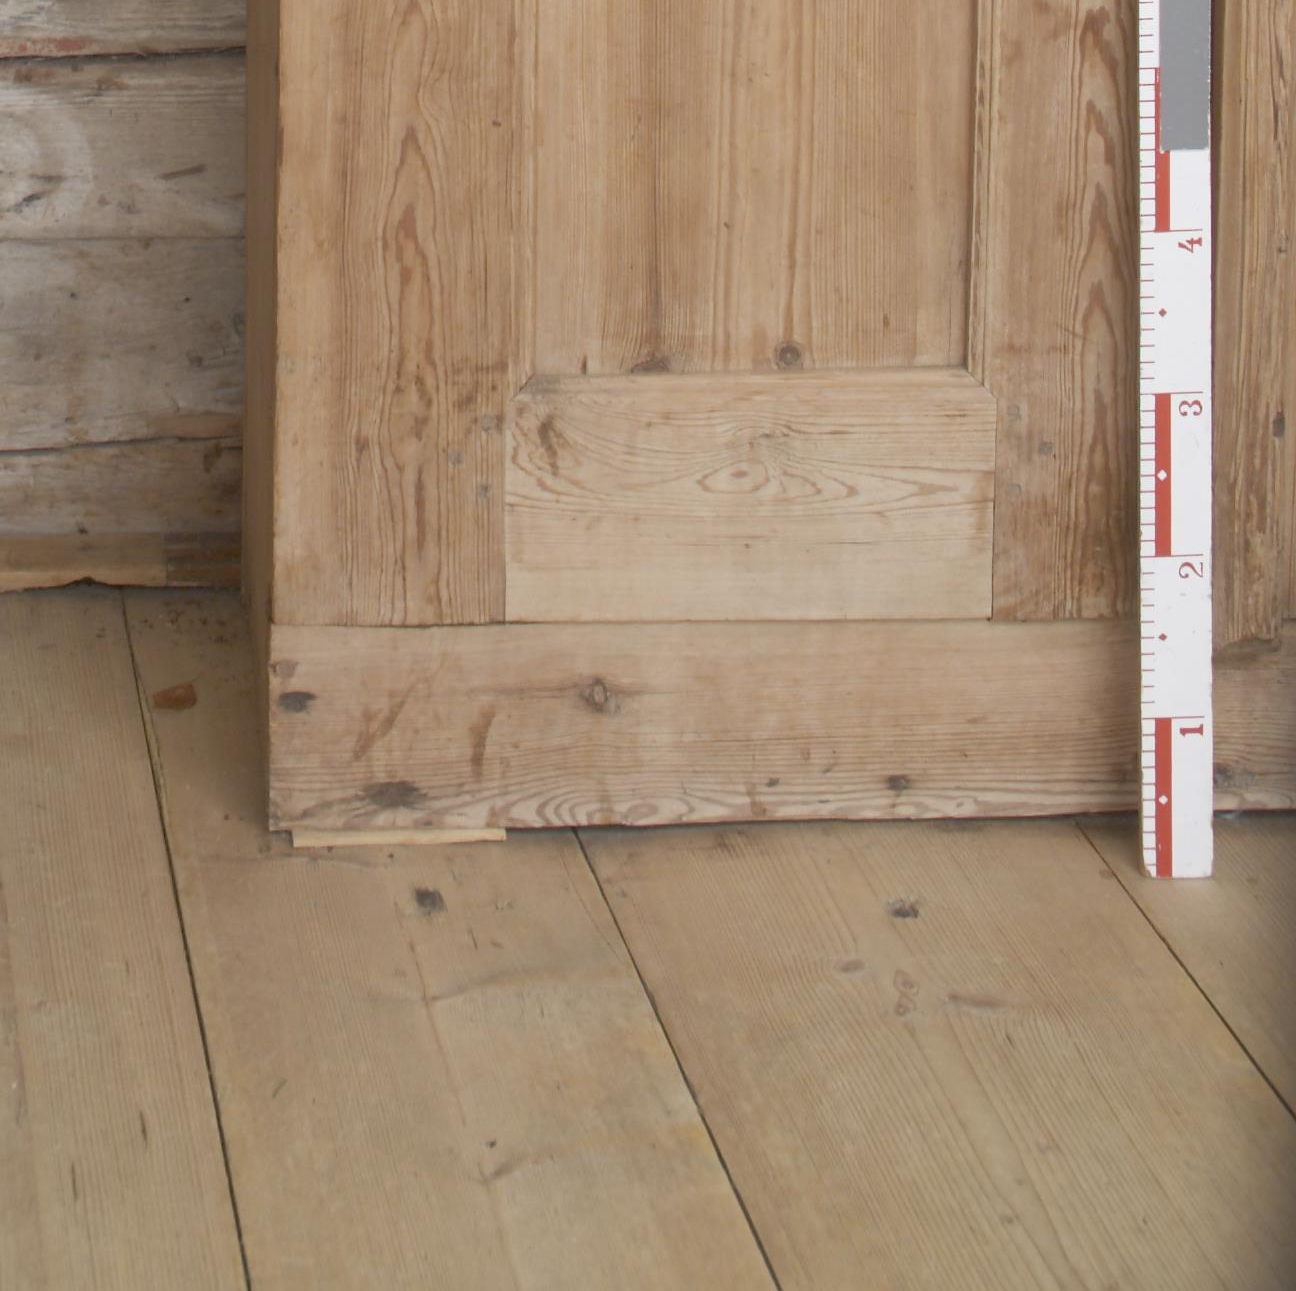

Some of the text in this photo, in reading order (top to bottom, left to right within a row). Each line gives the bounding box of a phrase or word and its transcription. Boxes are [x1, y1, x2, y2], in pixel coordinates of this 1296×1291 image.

[1178, 236, 1203, 253] 4
[1178, 399, 1203, 417] 3
[1178, 560, 1204, 579] 2
[1179, 723, 1205, 737] 1
